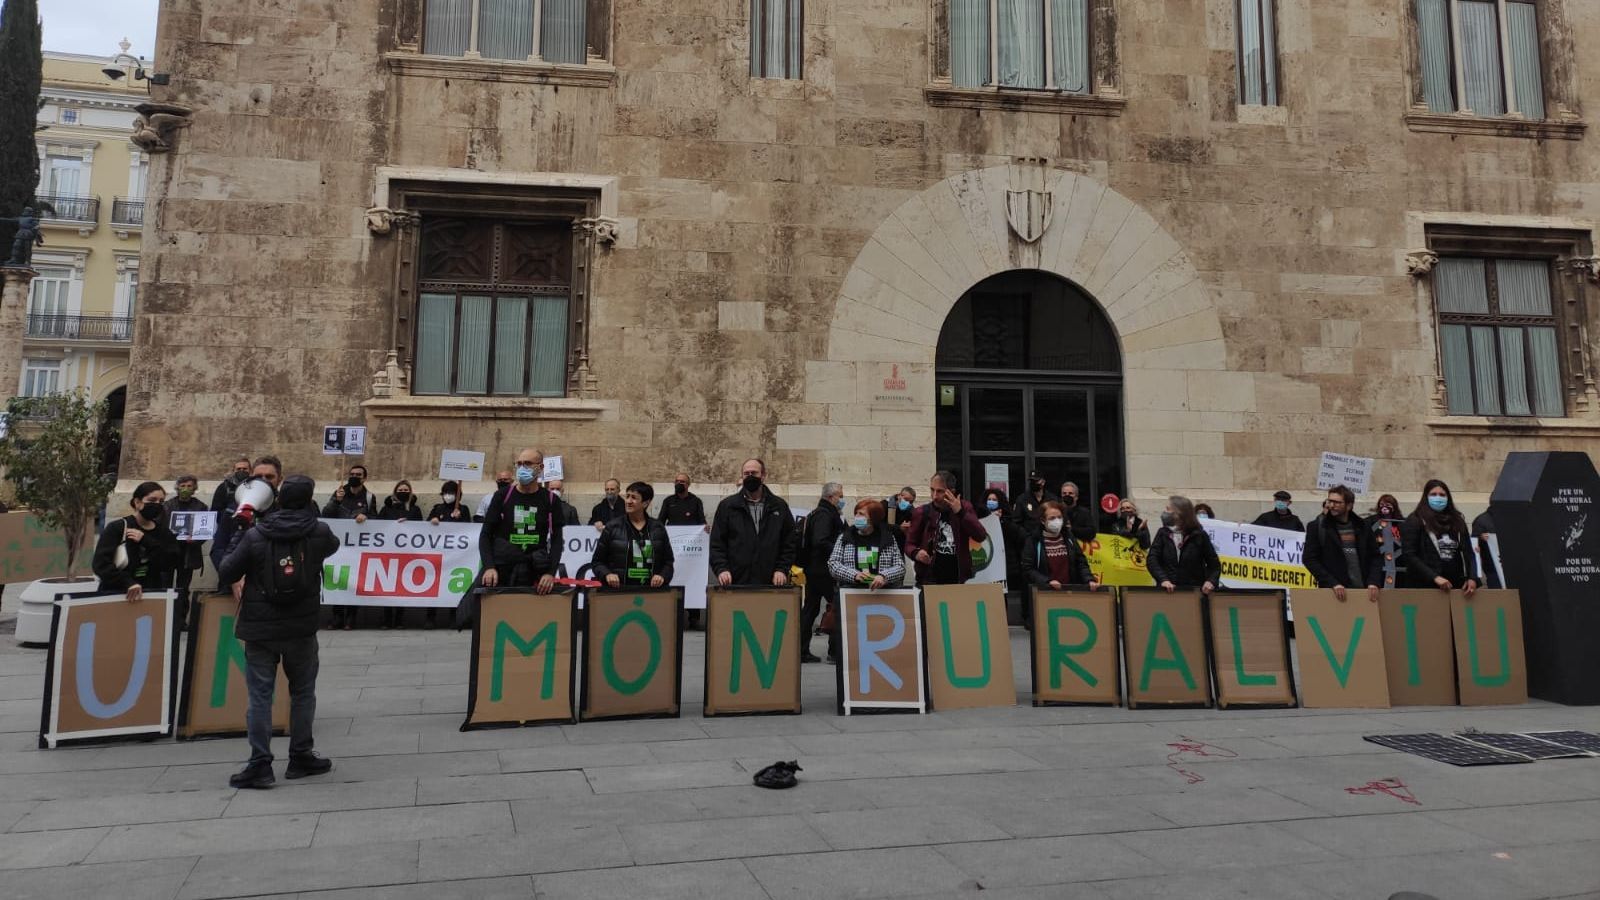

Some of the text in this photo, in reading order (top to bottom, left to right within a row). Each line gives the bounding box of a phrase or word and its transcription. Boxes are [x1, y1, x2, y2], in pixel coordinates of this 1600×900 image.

[1558, 488, 1584, 496] PER UN
[1569, 496, 1592, 504] RURAL
[344, 532, 385, 547] LES
[395, 533, 469, 550] COVES
[1232, 531, 1305, 551] PER UN M
[1240, 545, 1284, 562] RURAL
[324, 557, 477, 594] u NO a
[1252, 565, 1269, 581] DEL
[1271, 568, 1306, 586] DECRET
